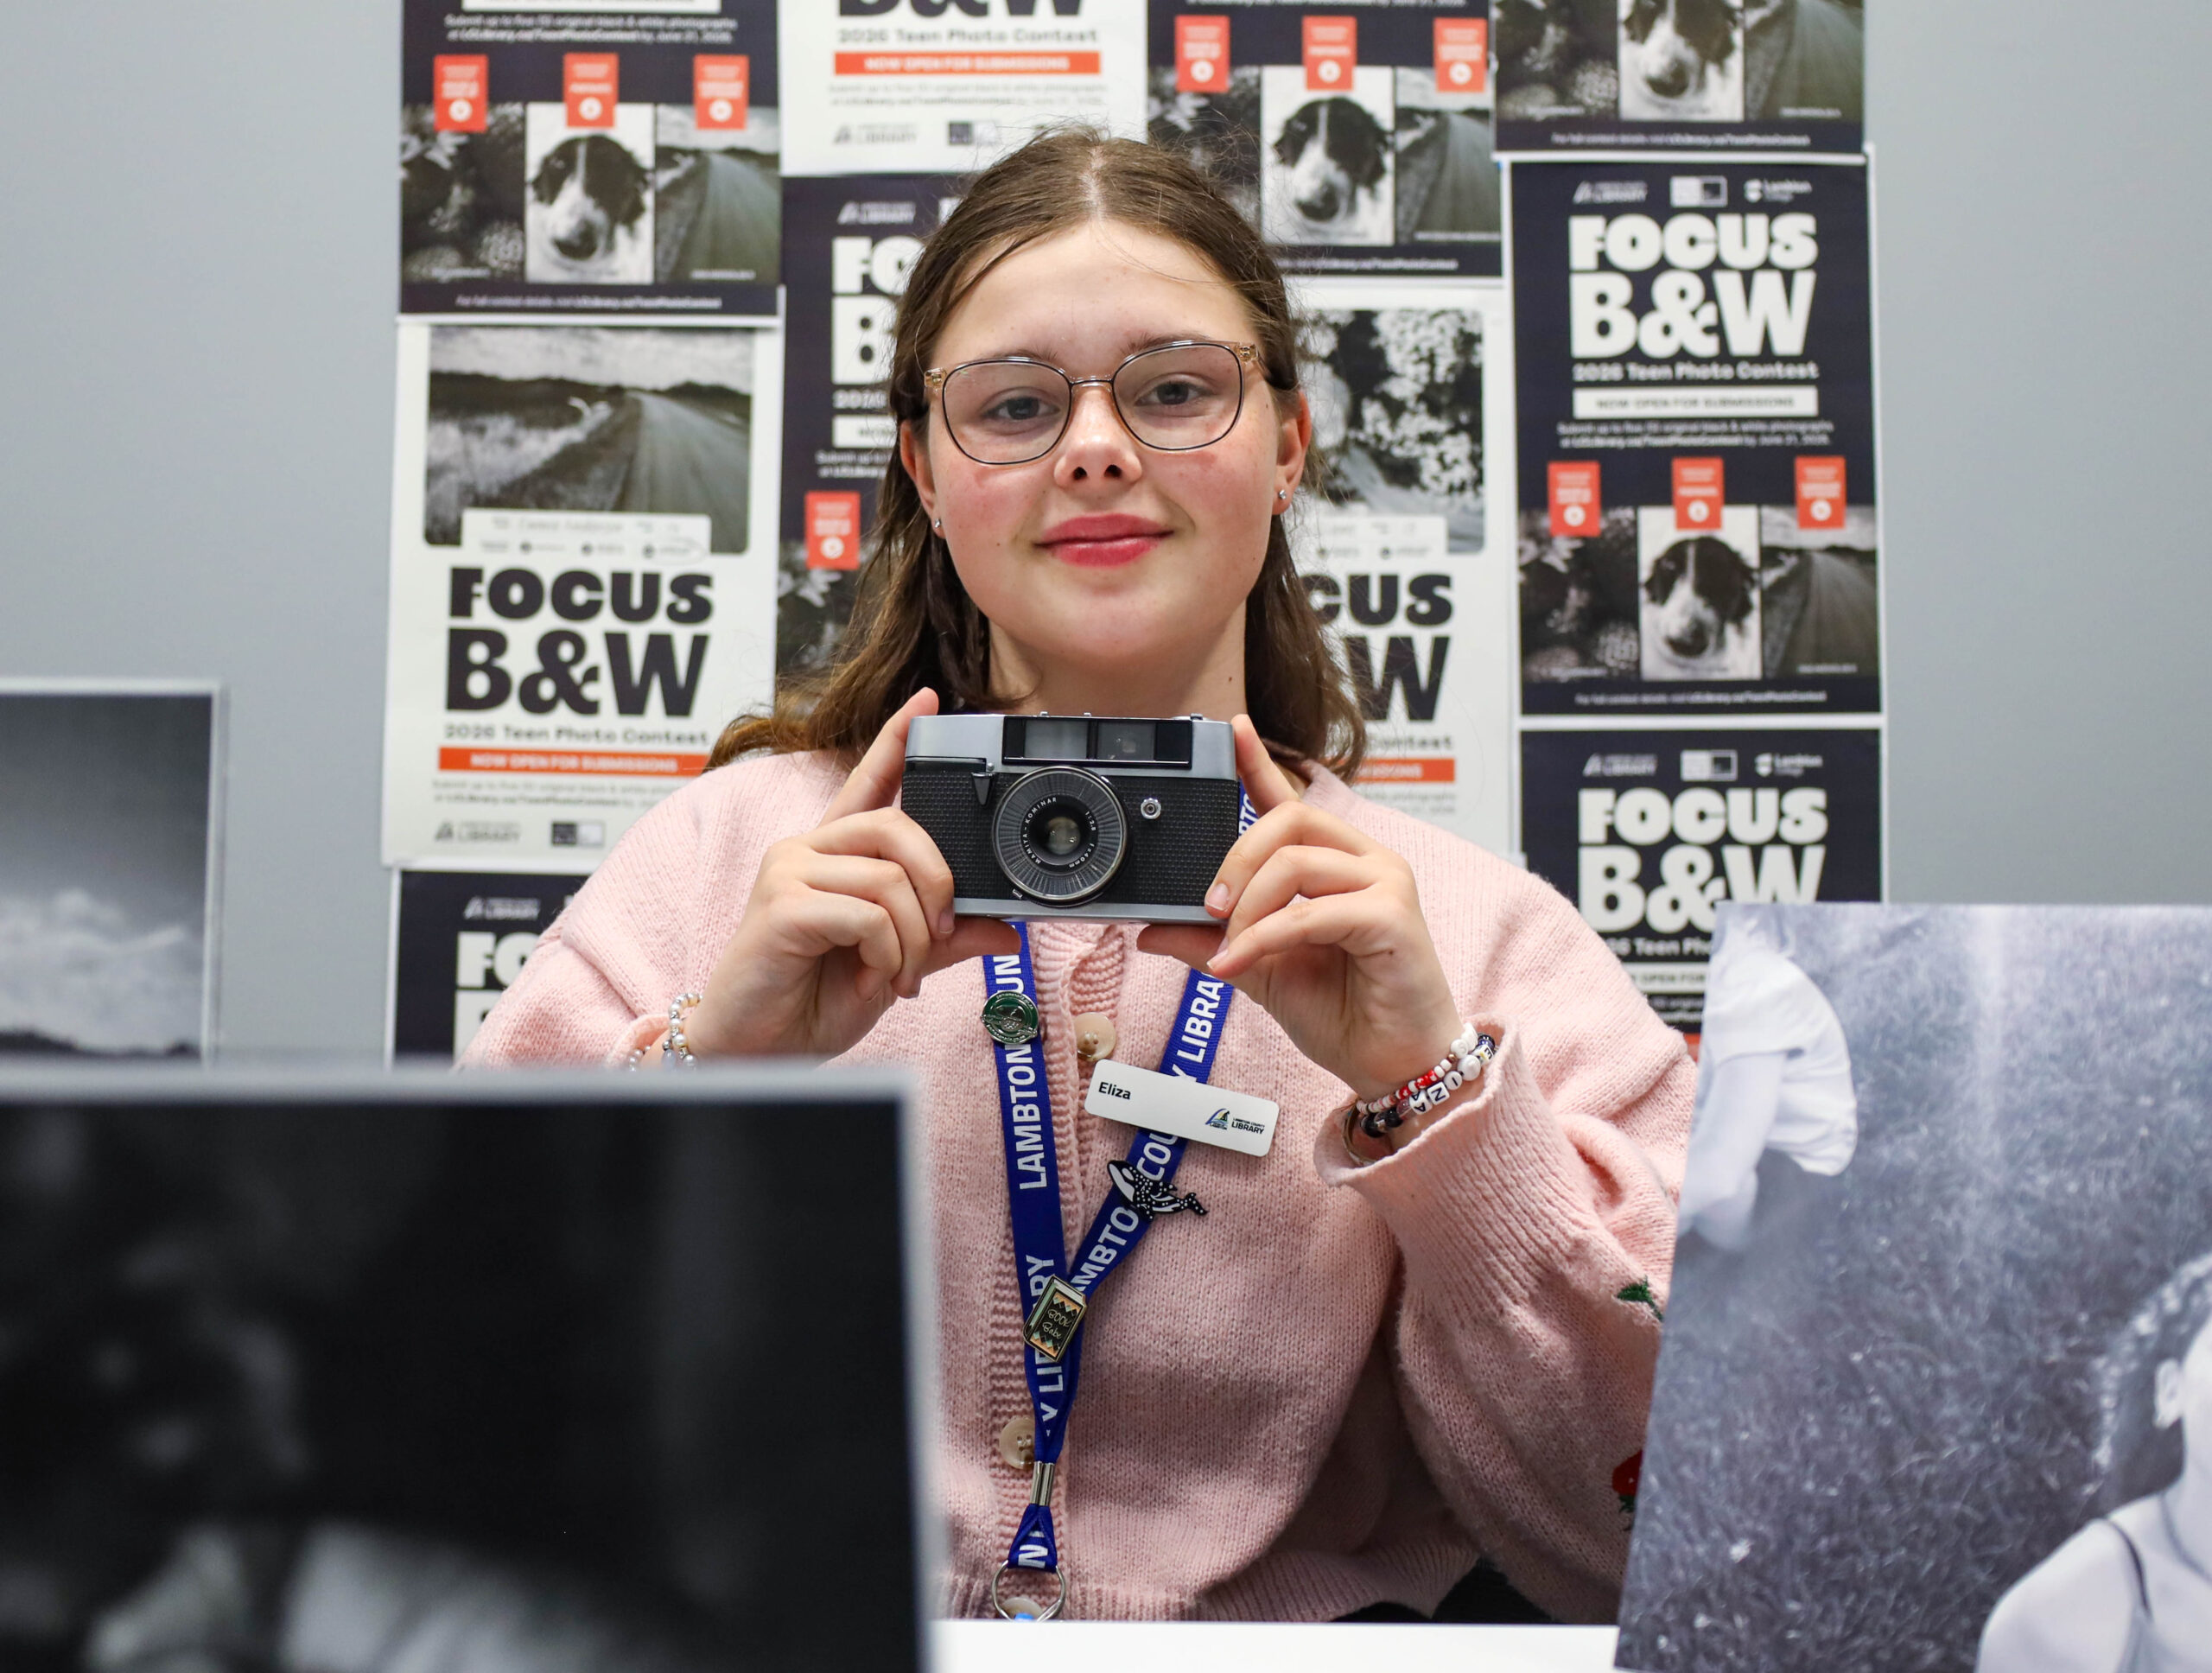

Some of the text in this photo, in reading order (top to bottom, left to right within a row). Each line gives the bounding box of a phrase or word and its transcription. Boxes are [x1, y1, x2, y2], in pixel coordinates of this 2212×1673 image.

[896, 29, 942, 43] Teen
[947, 28, 1007, 43] Photo
[1014, 28, 1098, 42] Contest
[865, 56, 1070, 71] NOW OPEN FOR SUBMISSIONS
[1569, 213, 1818, 272] FOCUS
[1569, 270, 1817, 359] B&W
[1627, 362, 1674, 380] Teen
[1675, 361, 1734, 380] Photo
[1737, 359, 1820, 379] Contest
[1596, 397, 1795, 410] NOW OPEN FOR SUBMISSIONS
[449, 567, 714, 625] FOCUS
[1300, 574, 1452, 627] CUS
[446, 627, 710, 717] B&W
[471, 752, 678, 773] NOW OPEN FOR SUBMISSIONS
[504, 726, 550, 741] Teen
[556, 728, 617, 743] Photo
[623, 729, 709, 746] Contest
[1579, 786, 1828, 845] FOCUS
[1578, 843, 1826, 934] B&W
[1634, 937, 1681, 957] Teen
[1682, 937, 1712, 957] Pho
[1177, 973, 1224, 1063] LIBRA
[1004, 1043, 1048, 1190] LAMBTON
[1098, 1081, 1131, 1100] Eliza
[1231, 1121, 1264, 1135] LIBRARY
[1071, 1206, 1140, 1292] MBTO
